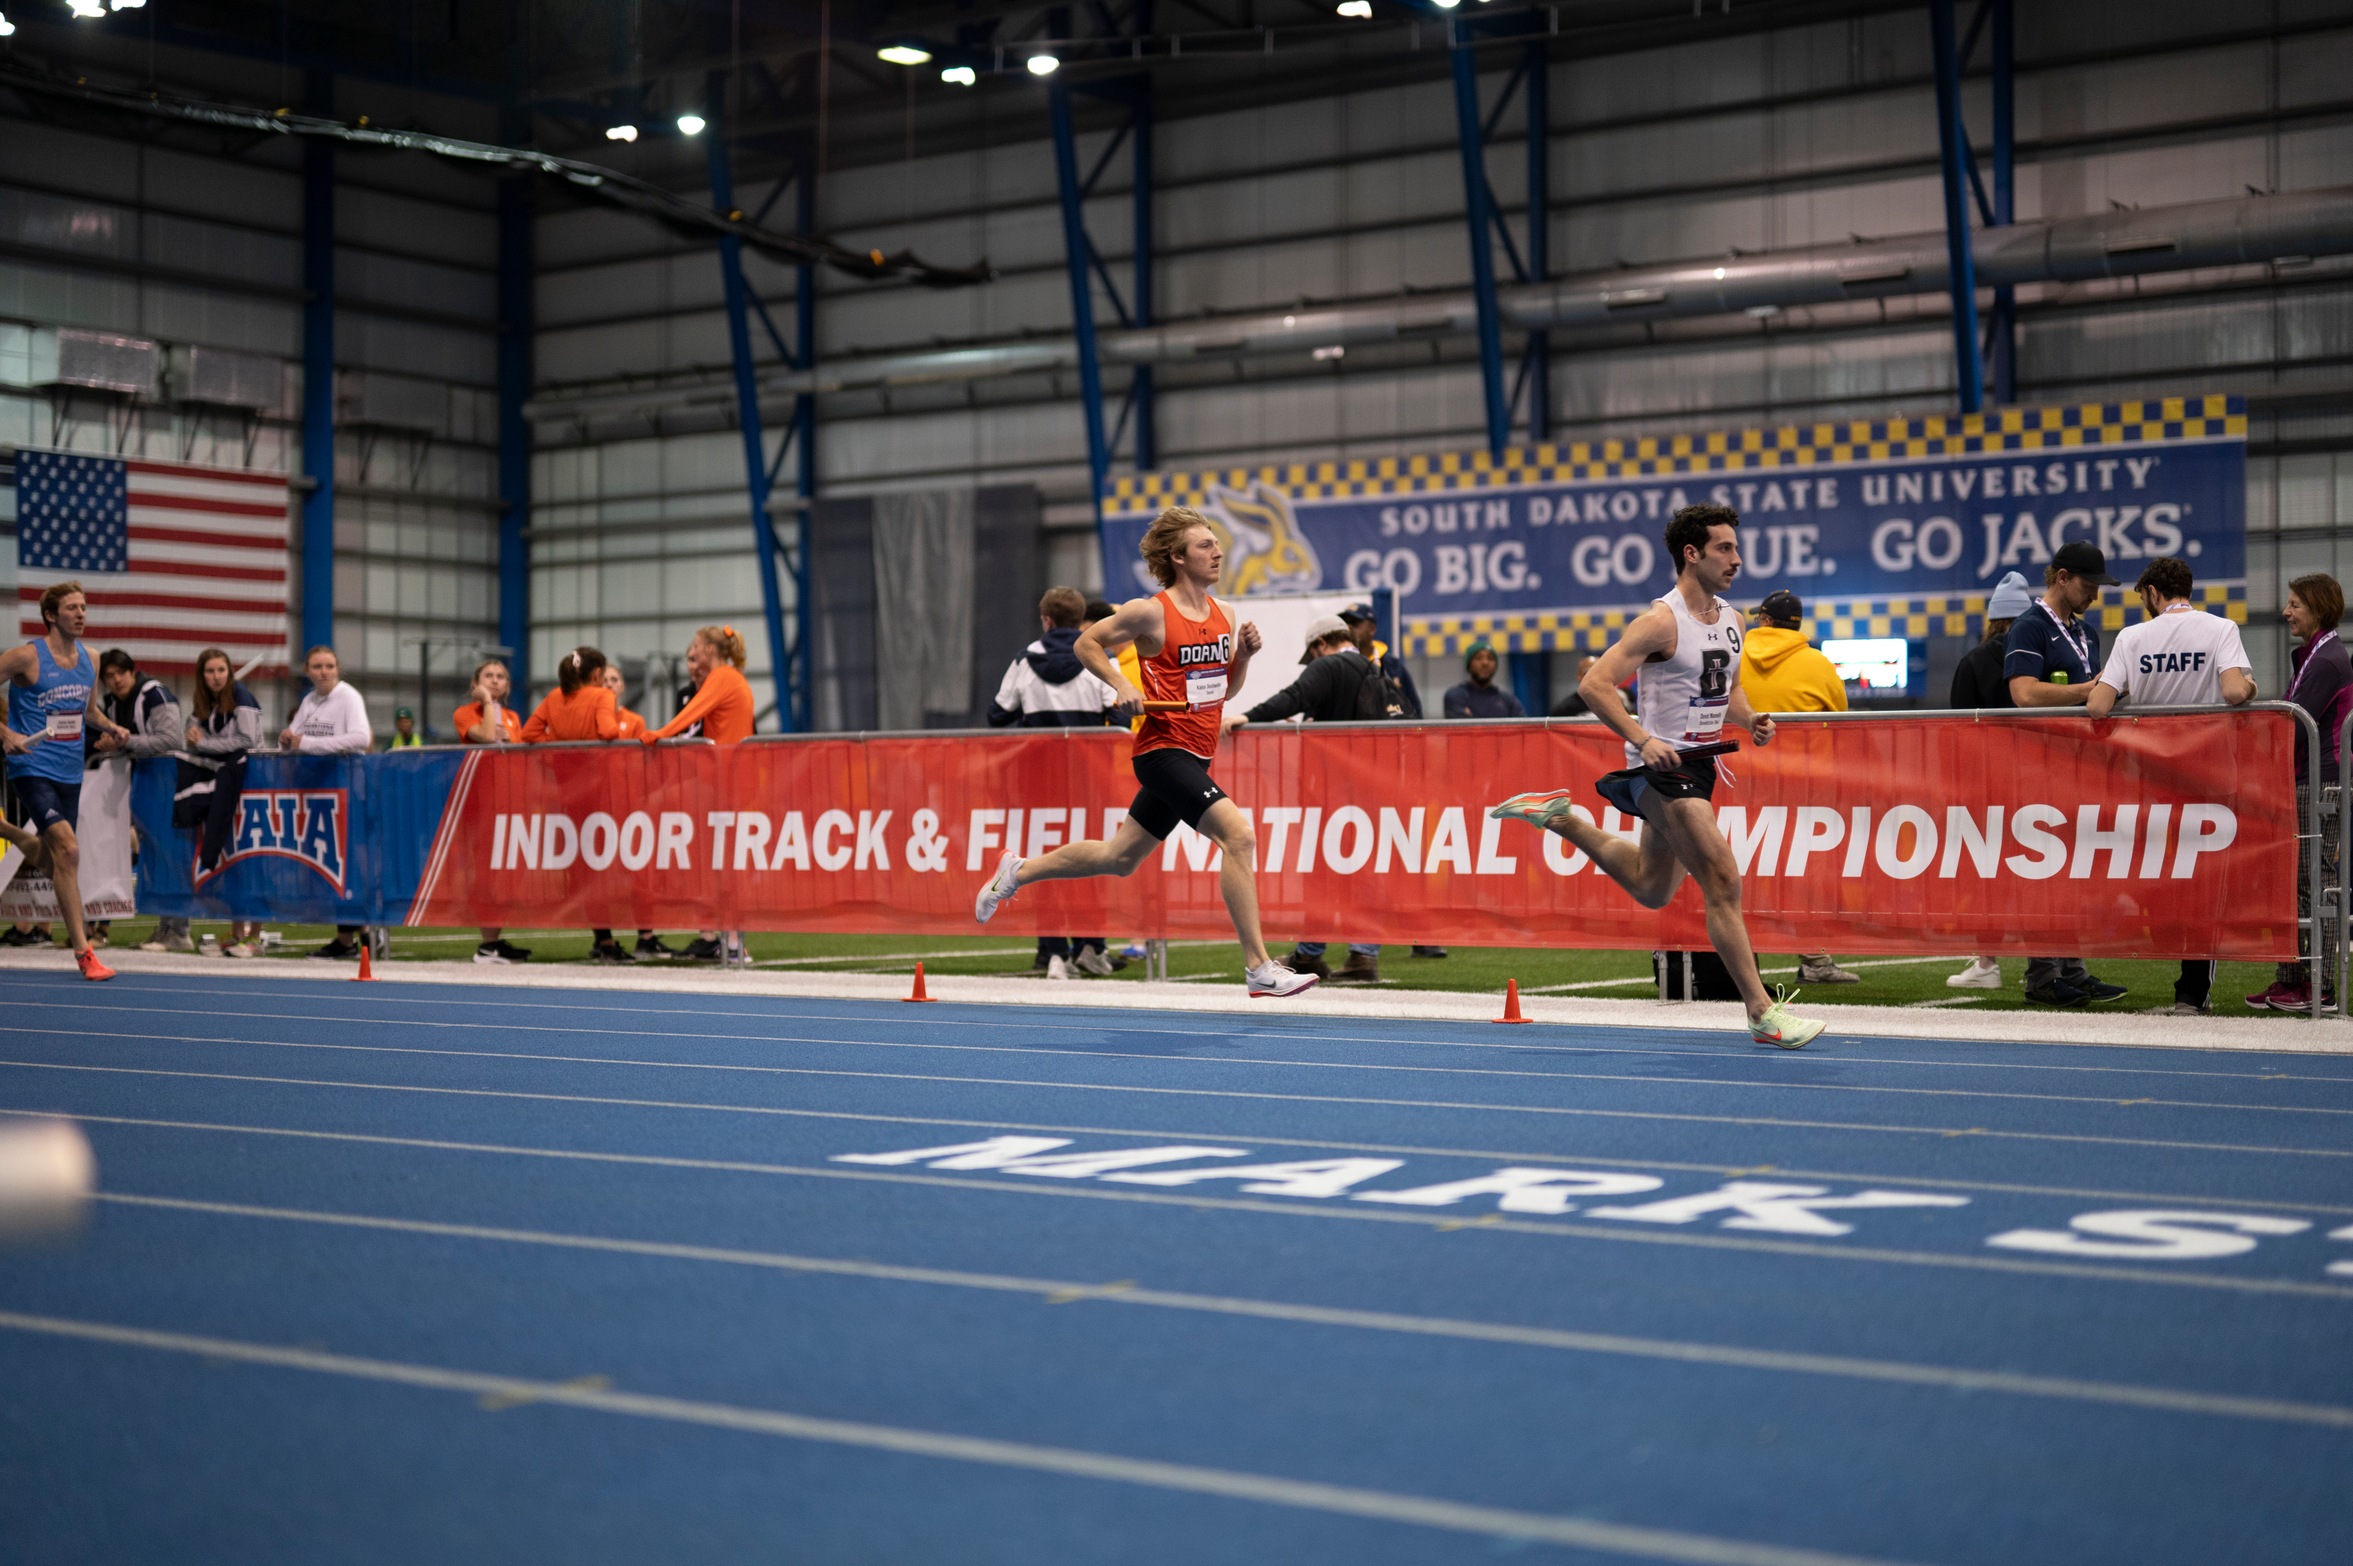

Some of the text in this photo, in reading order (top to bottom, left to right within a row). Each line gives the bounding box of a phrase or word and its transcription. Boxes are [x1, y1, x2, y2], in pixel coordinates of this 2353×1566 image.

[1380, 457, 2160, 537] SOUTH DAKOTA STATE UNIVERSITY
[1344, 548, 1422, 597] GO
[1434, 541, 1542, 596] BIG.
[1571, 533, 1655, 587] GO
[1871, 515, 1963, 572] GO
[1976, 502, 2202, 580] JACKS.
[1222, 635, 1229, 662] 6
[1726, 626, 1740, 654] 9
[2140, 652, 2206, 674] STAFF
[194, 793, 344, 888] AIA
[490, 811, 694, 871] INDOOR
[707, 808, 893, 871] TRACK
[905, 807, 949, 873] &
[1542, 803, 2238, 880] CHMPIONSHIP
[828, 1135, 1972, 1236] MARK
